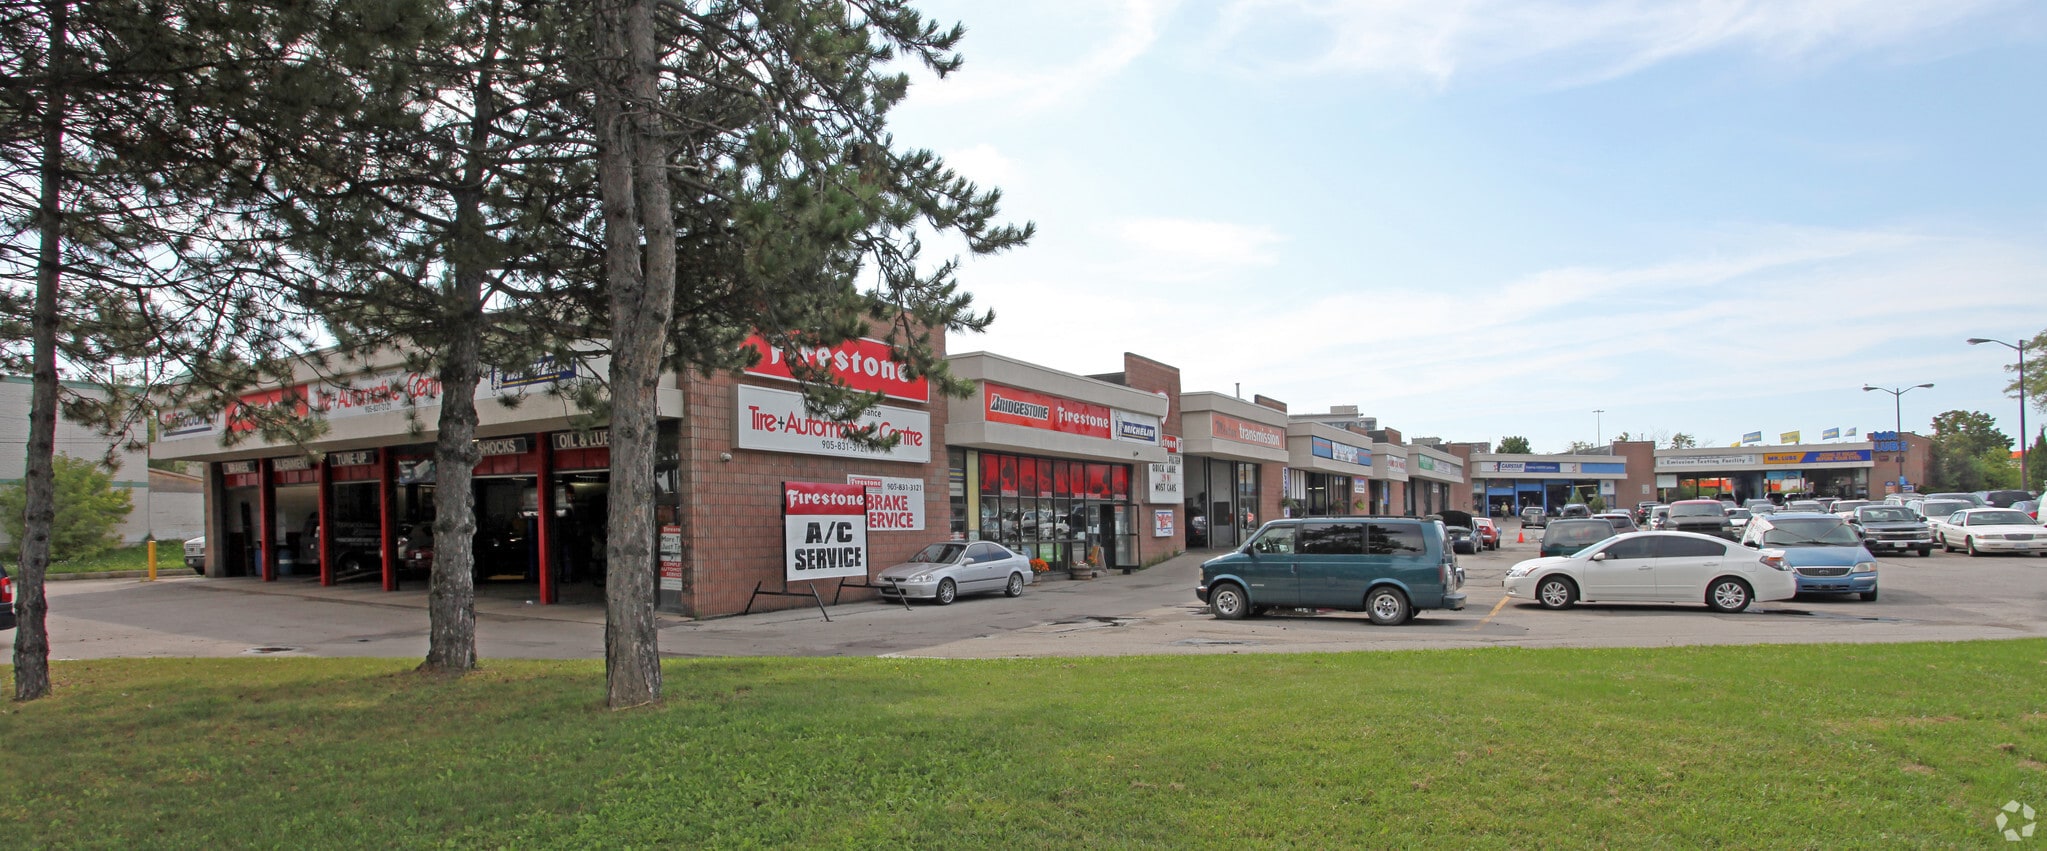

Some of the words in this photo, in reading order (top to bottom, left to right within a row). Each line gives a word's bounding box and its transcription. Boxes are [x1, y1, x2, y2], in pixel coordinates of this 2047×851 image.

[990, 393, 1049, 421] BRIDGESTONE
[1057, 406, 1109, 429] Firestone
[1123, 424, 1154, 438] MICHELIN
[1239, 423, 1280, 446] transmission
[559, 434, 577, 448] OIL
[579, 433, 588, 446] &
[590, 431, 609, 446] LUB
[821, 439, 868, 453] 905-831-3121
[1873, 441, 1908, 452] LUBE
[477, 440, 516, 455] SHOCKS
[274, 458, 309, 471] ALIGNMENT
[336, 451, 367, 465] TUNE-UP
[1152, 464, 1164, 472] QUICK
[850, 479, 882, 487] Firestone
[1155, 483, 1165, 491] MOST
[1167, 484, 1176, 492] CARS
[786, 489, 865, 508] Firestone
[866, 494, 909, 511] BRAKE
[866, 512, 914, 528] ERVICE
[805, 521, 853, 544] A/C
[795, 547, 862, 571] SERVICE
